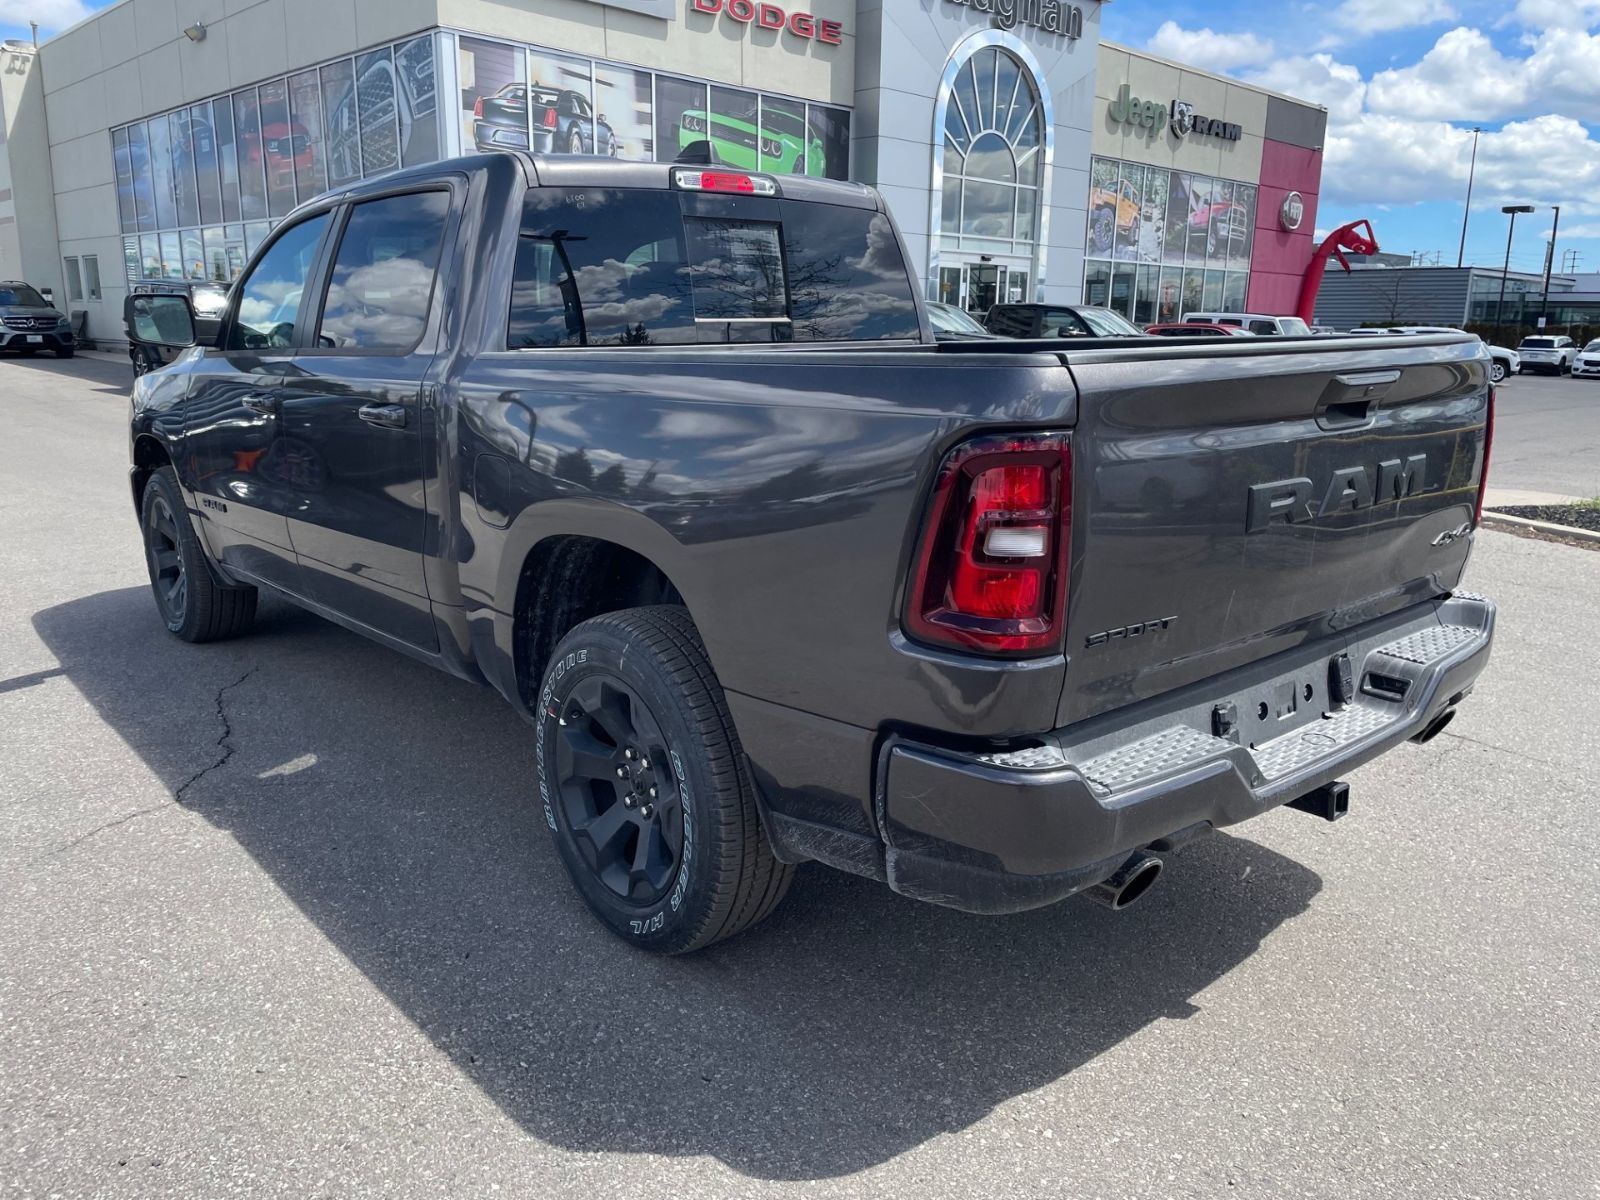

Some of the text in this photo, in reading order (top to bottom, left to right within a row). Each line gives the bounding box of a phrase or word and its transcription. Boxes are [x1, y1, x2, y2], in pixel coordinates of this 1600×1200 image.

[690, 0, 843, 46] DODGE
[1108, 83, 1168, 138] Jeep
[1191, 114, 1242, 142] RAM
[1245, 453, 1427, 534] RAM
[1084, 615, 1179, 648] SPORT
[536, 649, 588, 833] BRIDGESTONE
[630, 911, 664, 934] H/L
